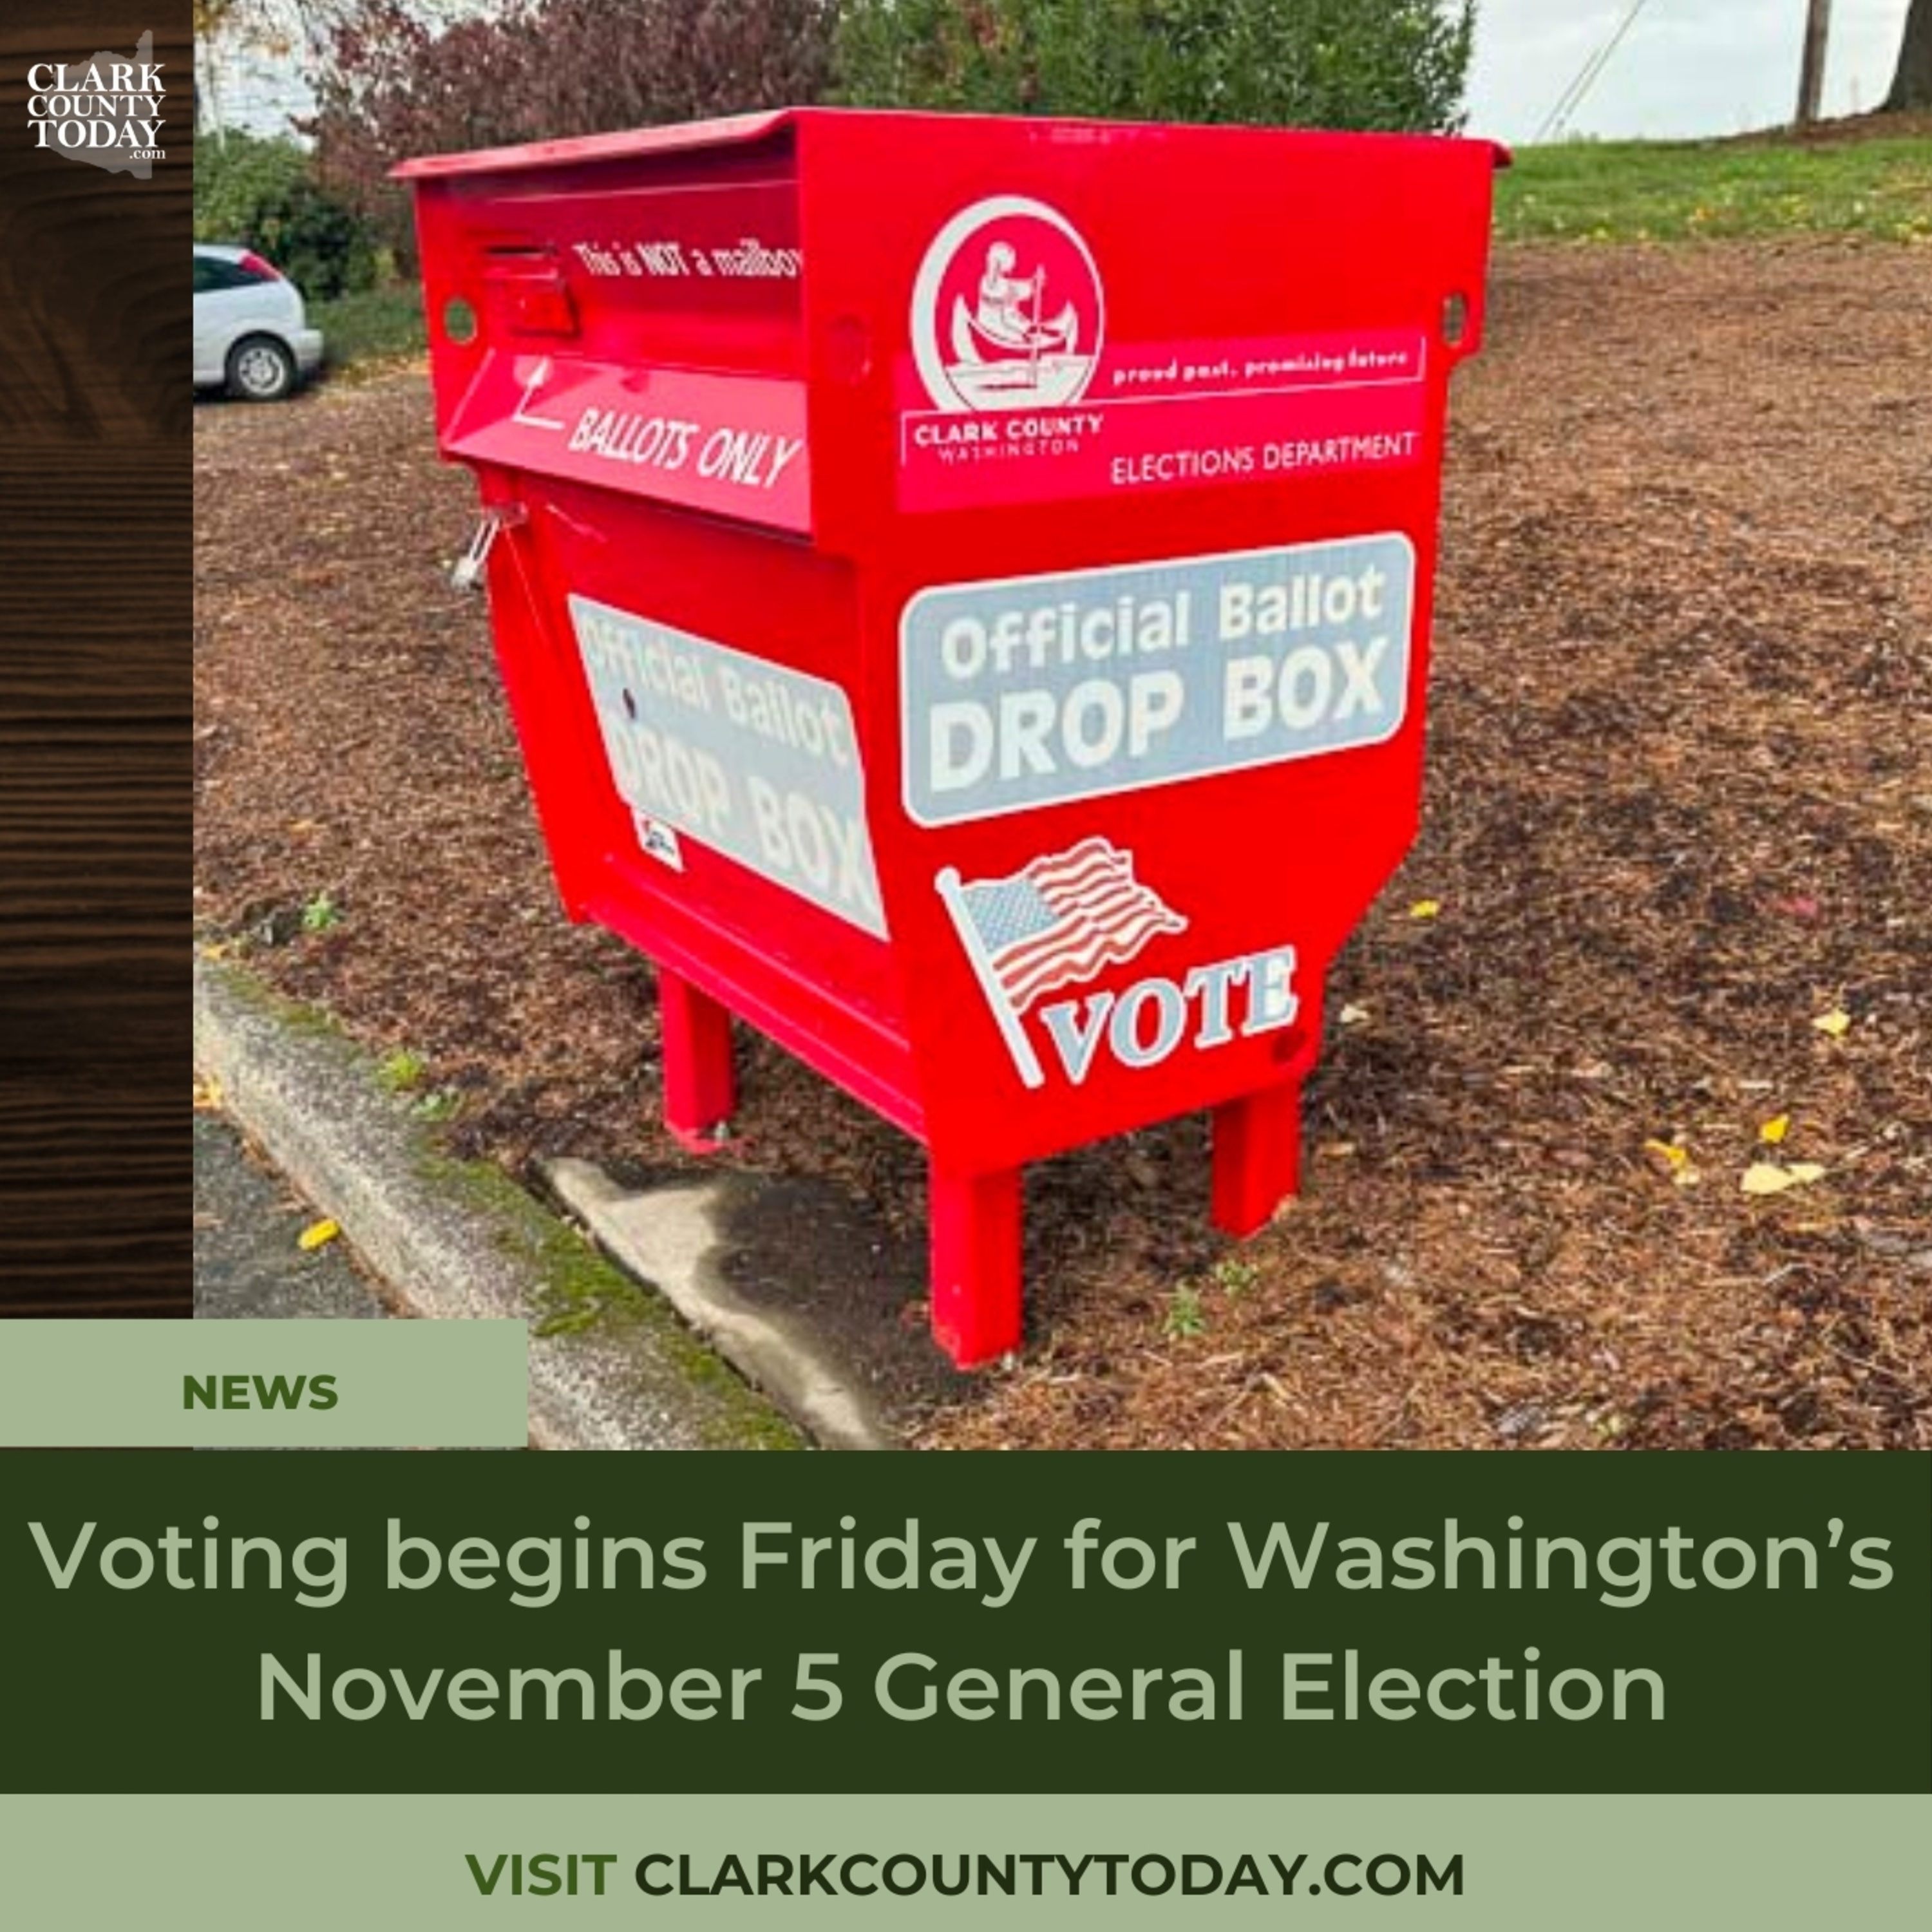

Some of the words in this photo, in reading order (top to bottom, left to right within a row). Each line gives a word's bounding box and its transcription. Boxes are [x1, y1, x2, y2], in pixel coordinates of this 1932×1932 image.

[572, 241, 621, 276] This
[612, 242, 643, 276] is
[635, 241, 690, 276] NOT
[691, 249, 714, 276] a
[1113, 358, 1178, 385] proud
[1244, 353, 1345, 379] promising
[1348, 347, 1408, 368] future
[568, 408, 701, 470] BALLOTS
[696, 428, 802, 489] ONLY
[914, 421, 998, 447] CLARK
[1006, 414, 1104, 440] COUNTY
[937, 439, 1079, 466] WASHINGTON
[1110, 446, 1255, 485] ELECTIONS
[1262, 431, 1417, 470] DEPARTMENT
[940, 591, 1190, 680] Official
[1219, 563, 1387, 639] Ballot
[718, 665, 850, 766] Ballot
[929, 670, 1185, 794] DROP
[1222, 636, 1388, 741] BOX
[604, 708, 732, 835] DROP
[748, 775, 880, 914] BOX
[1039, 944, 1299, 1085] VOTE
